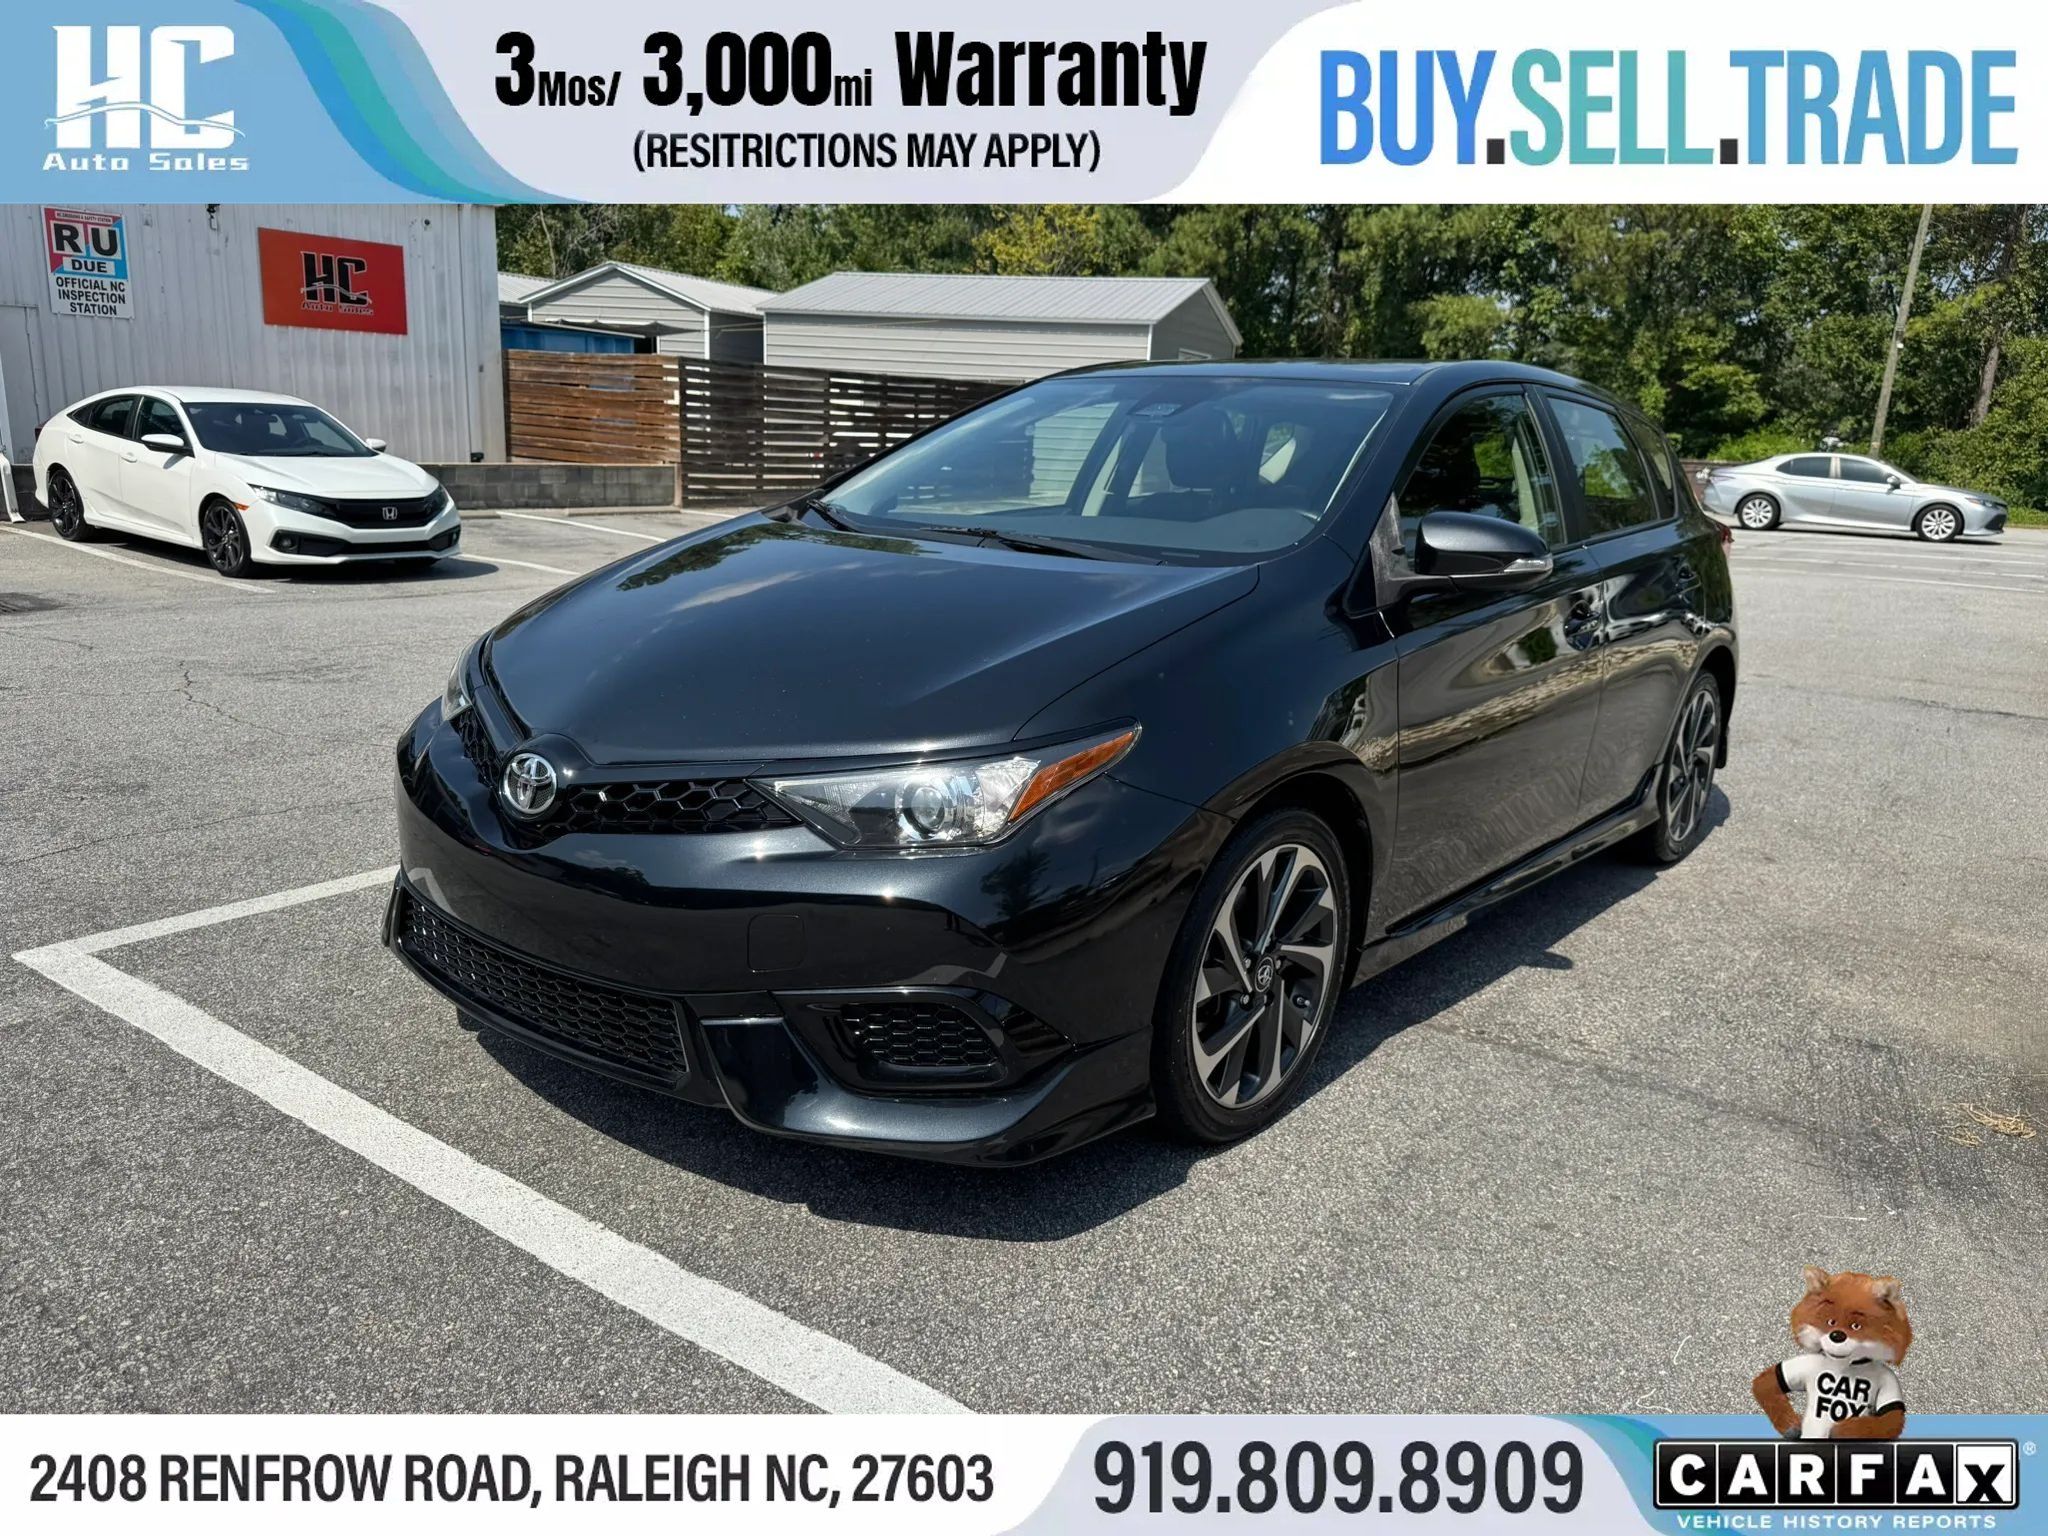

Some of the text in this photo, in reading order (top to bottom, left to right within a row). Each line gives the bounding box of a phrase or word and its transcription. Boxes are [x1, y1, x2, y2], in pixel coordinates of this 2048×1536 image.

[53, 223, 118, 256] R U
[71, 259, 107, 273] DUE
[56, 276, 125, 292] OFFICIAL NC
[300, 251, 368, 307] HC
[58, 289, 126, 304] INSPECTION
[70, 302, 117, 316] STATION
